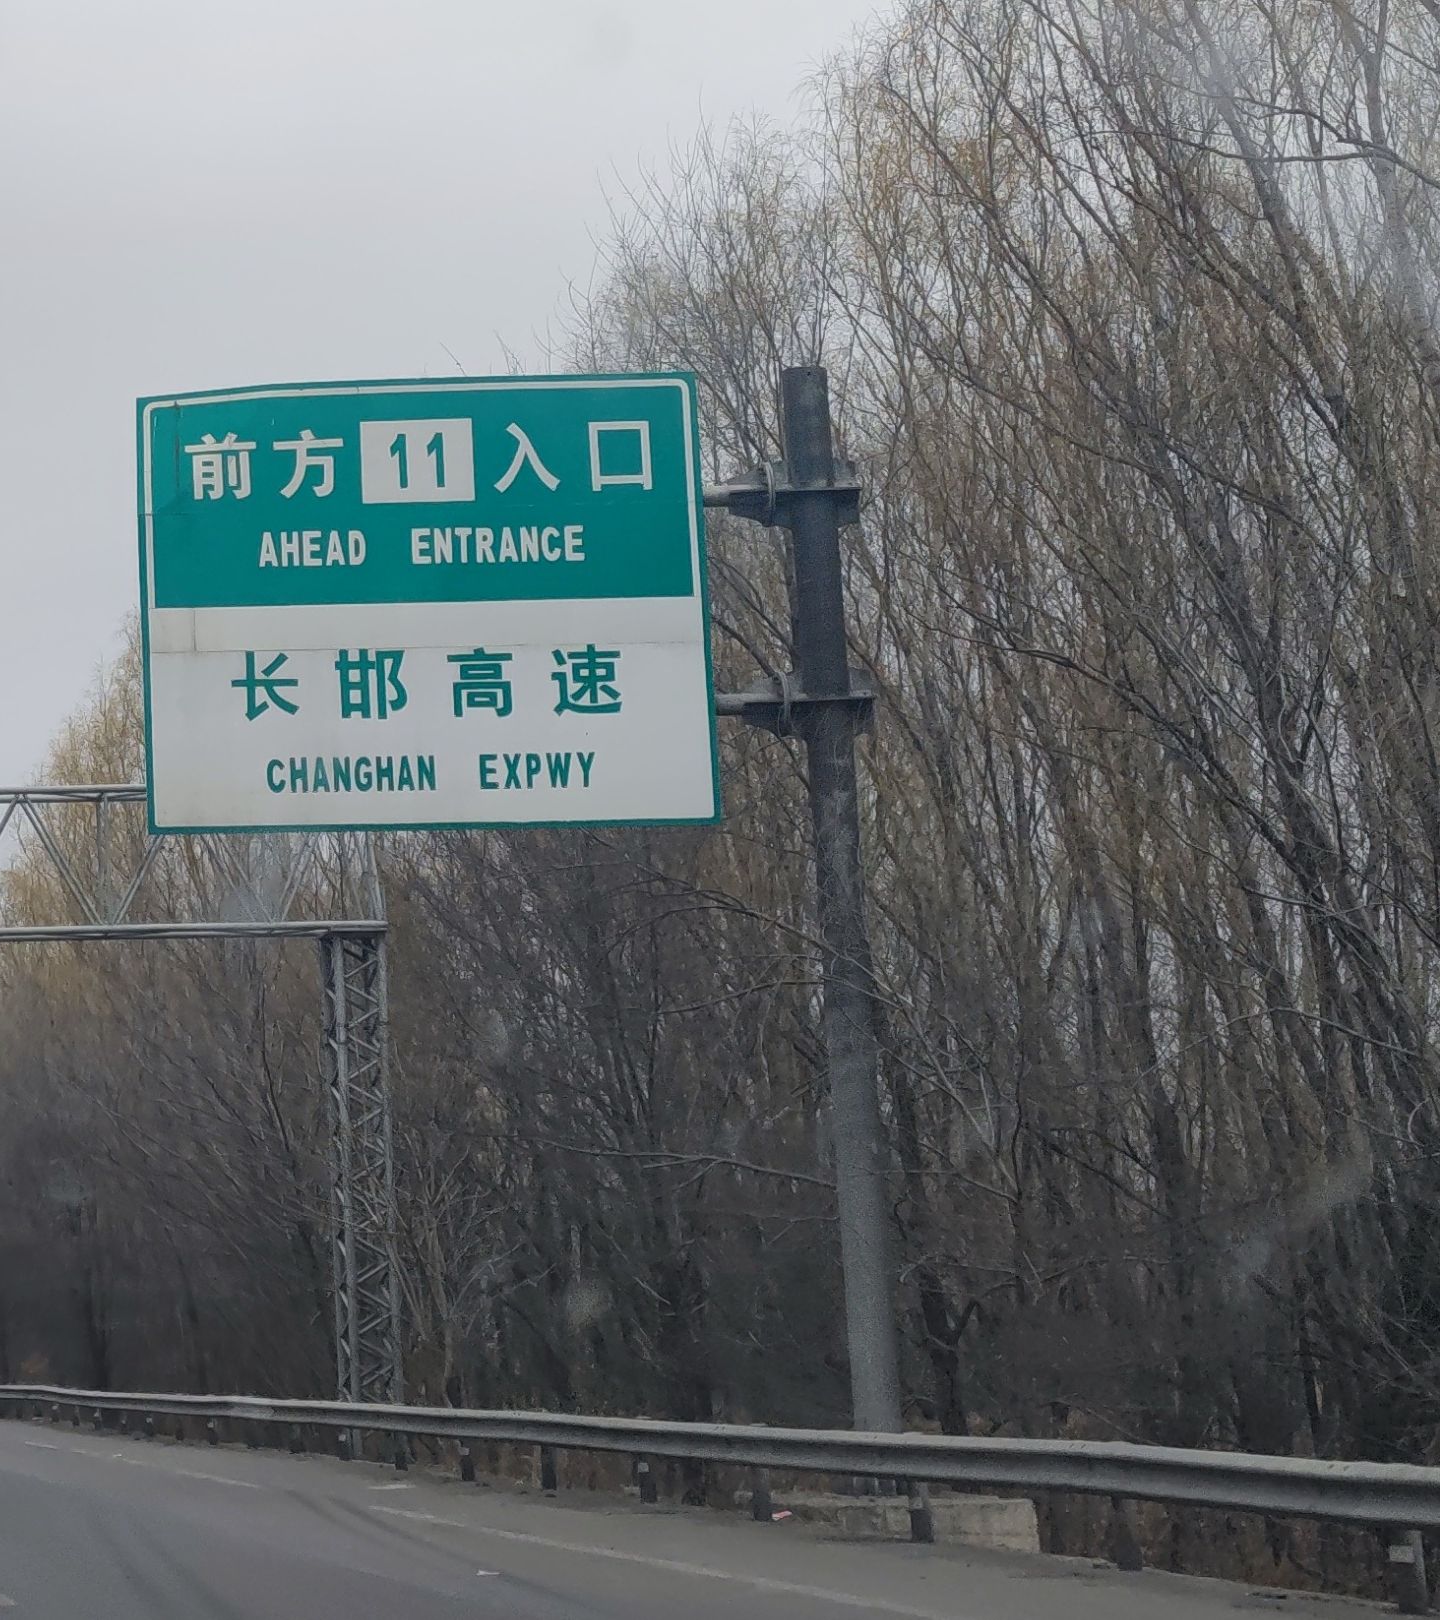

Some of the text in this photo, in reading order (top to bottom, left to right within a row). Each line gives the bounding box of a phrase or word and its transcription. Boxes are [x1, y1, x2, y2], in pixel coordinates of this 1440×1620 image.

[185, 420, 653, 499] 前方 11 入口
[259, 524, 585, 568] AHEAD ENTRANCE
[231, 643, 622, 721] 长邯高速
[266, 751, 595, 794] CHANGHAN EXPWY
